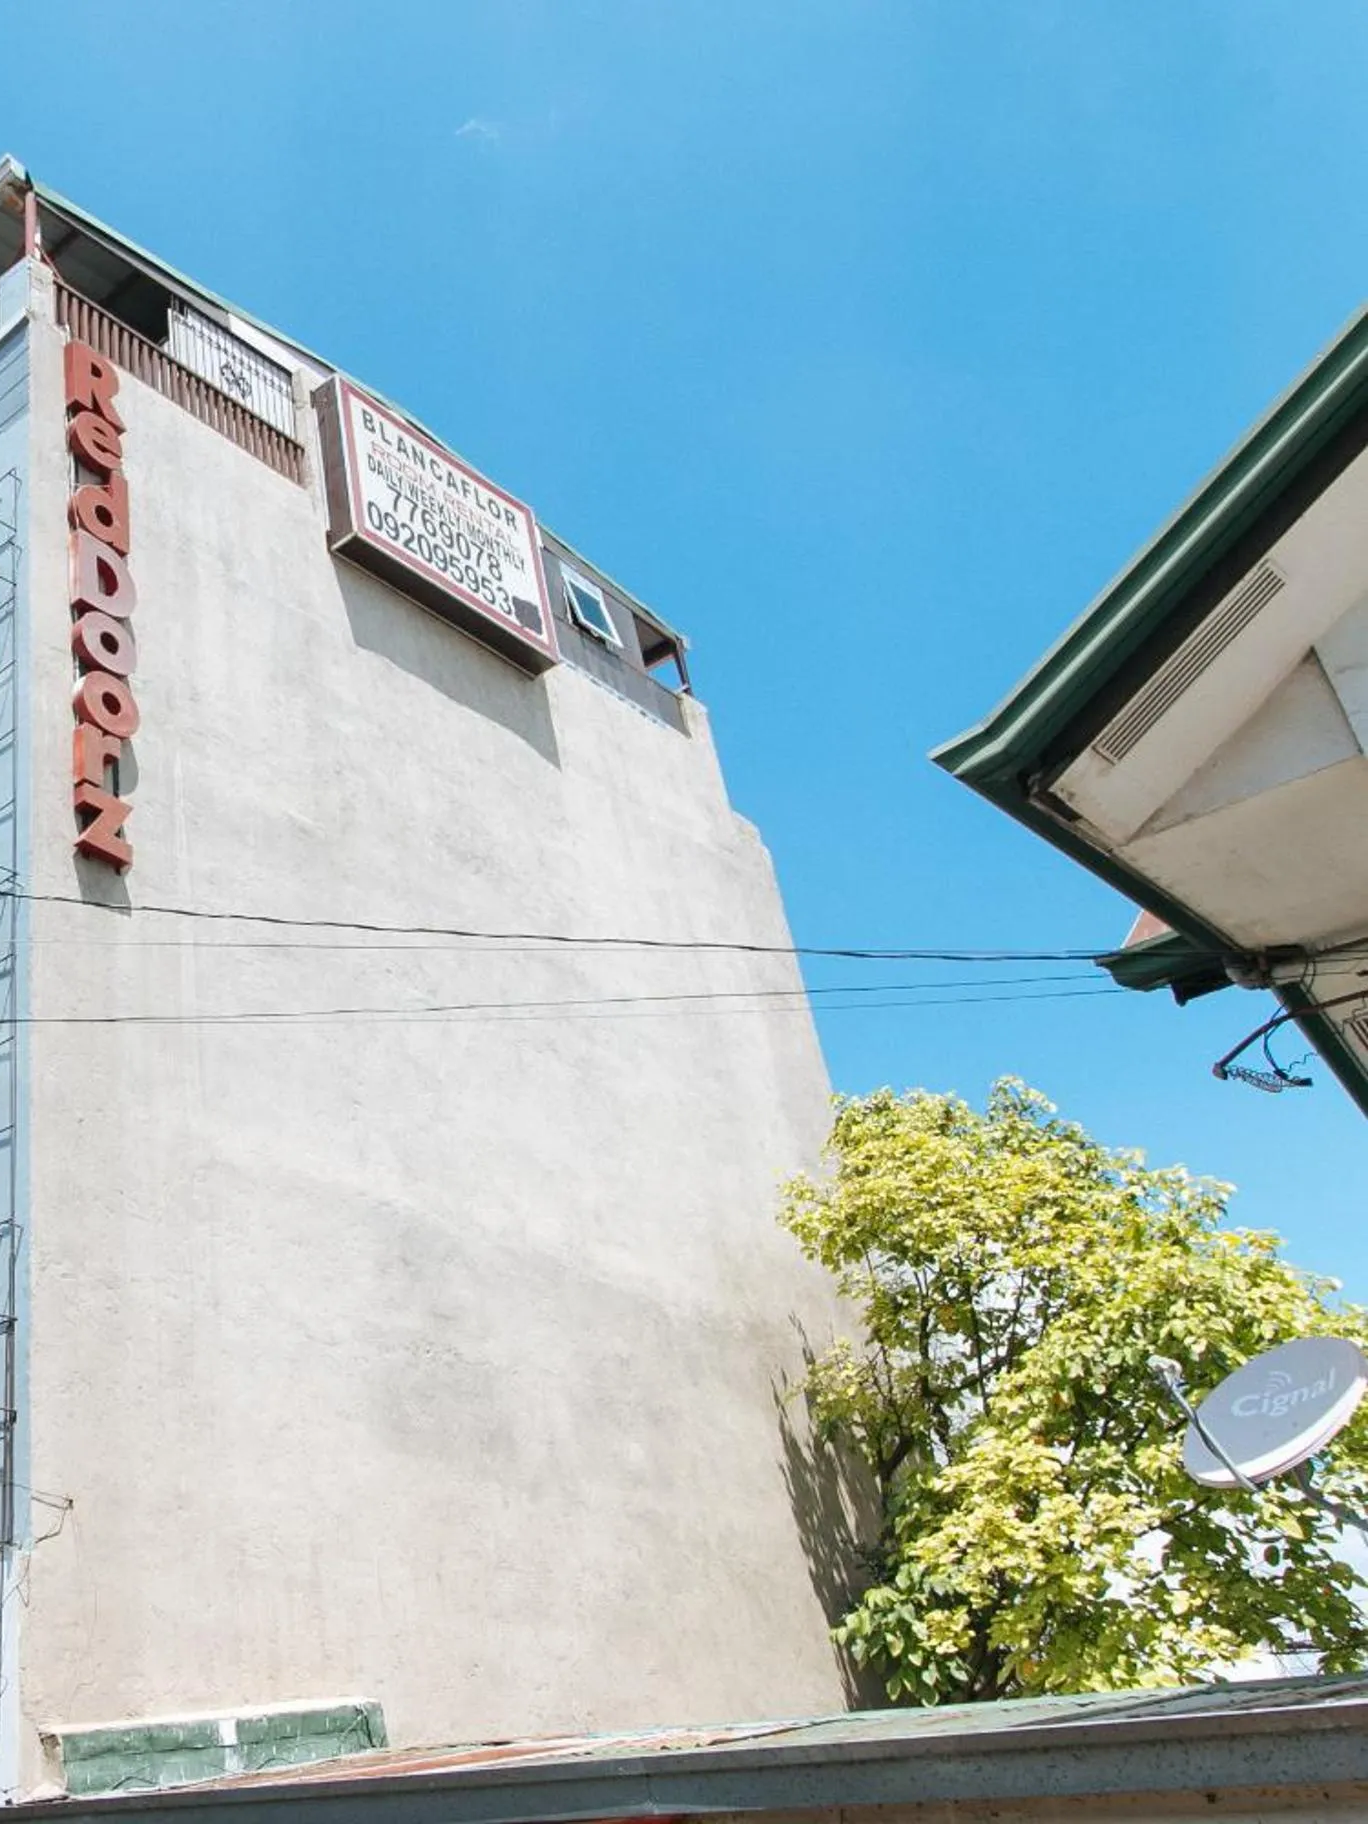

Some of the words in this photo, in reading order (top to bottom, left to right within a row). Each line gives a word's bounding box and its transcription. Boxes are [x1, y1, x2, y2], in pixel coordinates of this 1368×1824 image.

[362, 409, 517, 531] BLANCAFLOR
[371, 440, 436, 497] ROOM
[443, 490, 521, 553] RENTAL
[367, 501, 512, 615] 092095953
[386, 483, 503, 582] 7769078
[1232, 1367, 1336, 1418] Cignal
